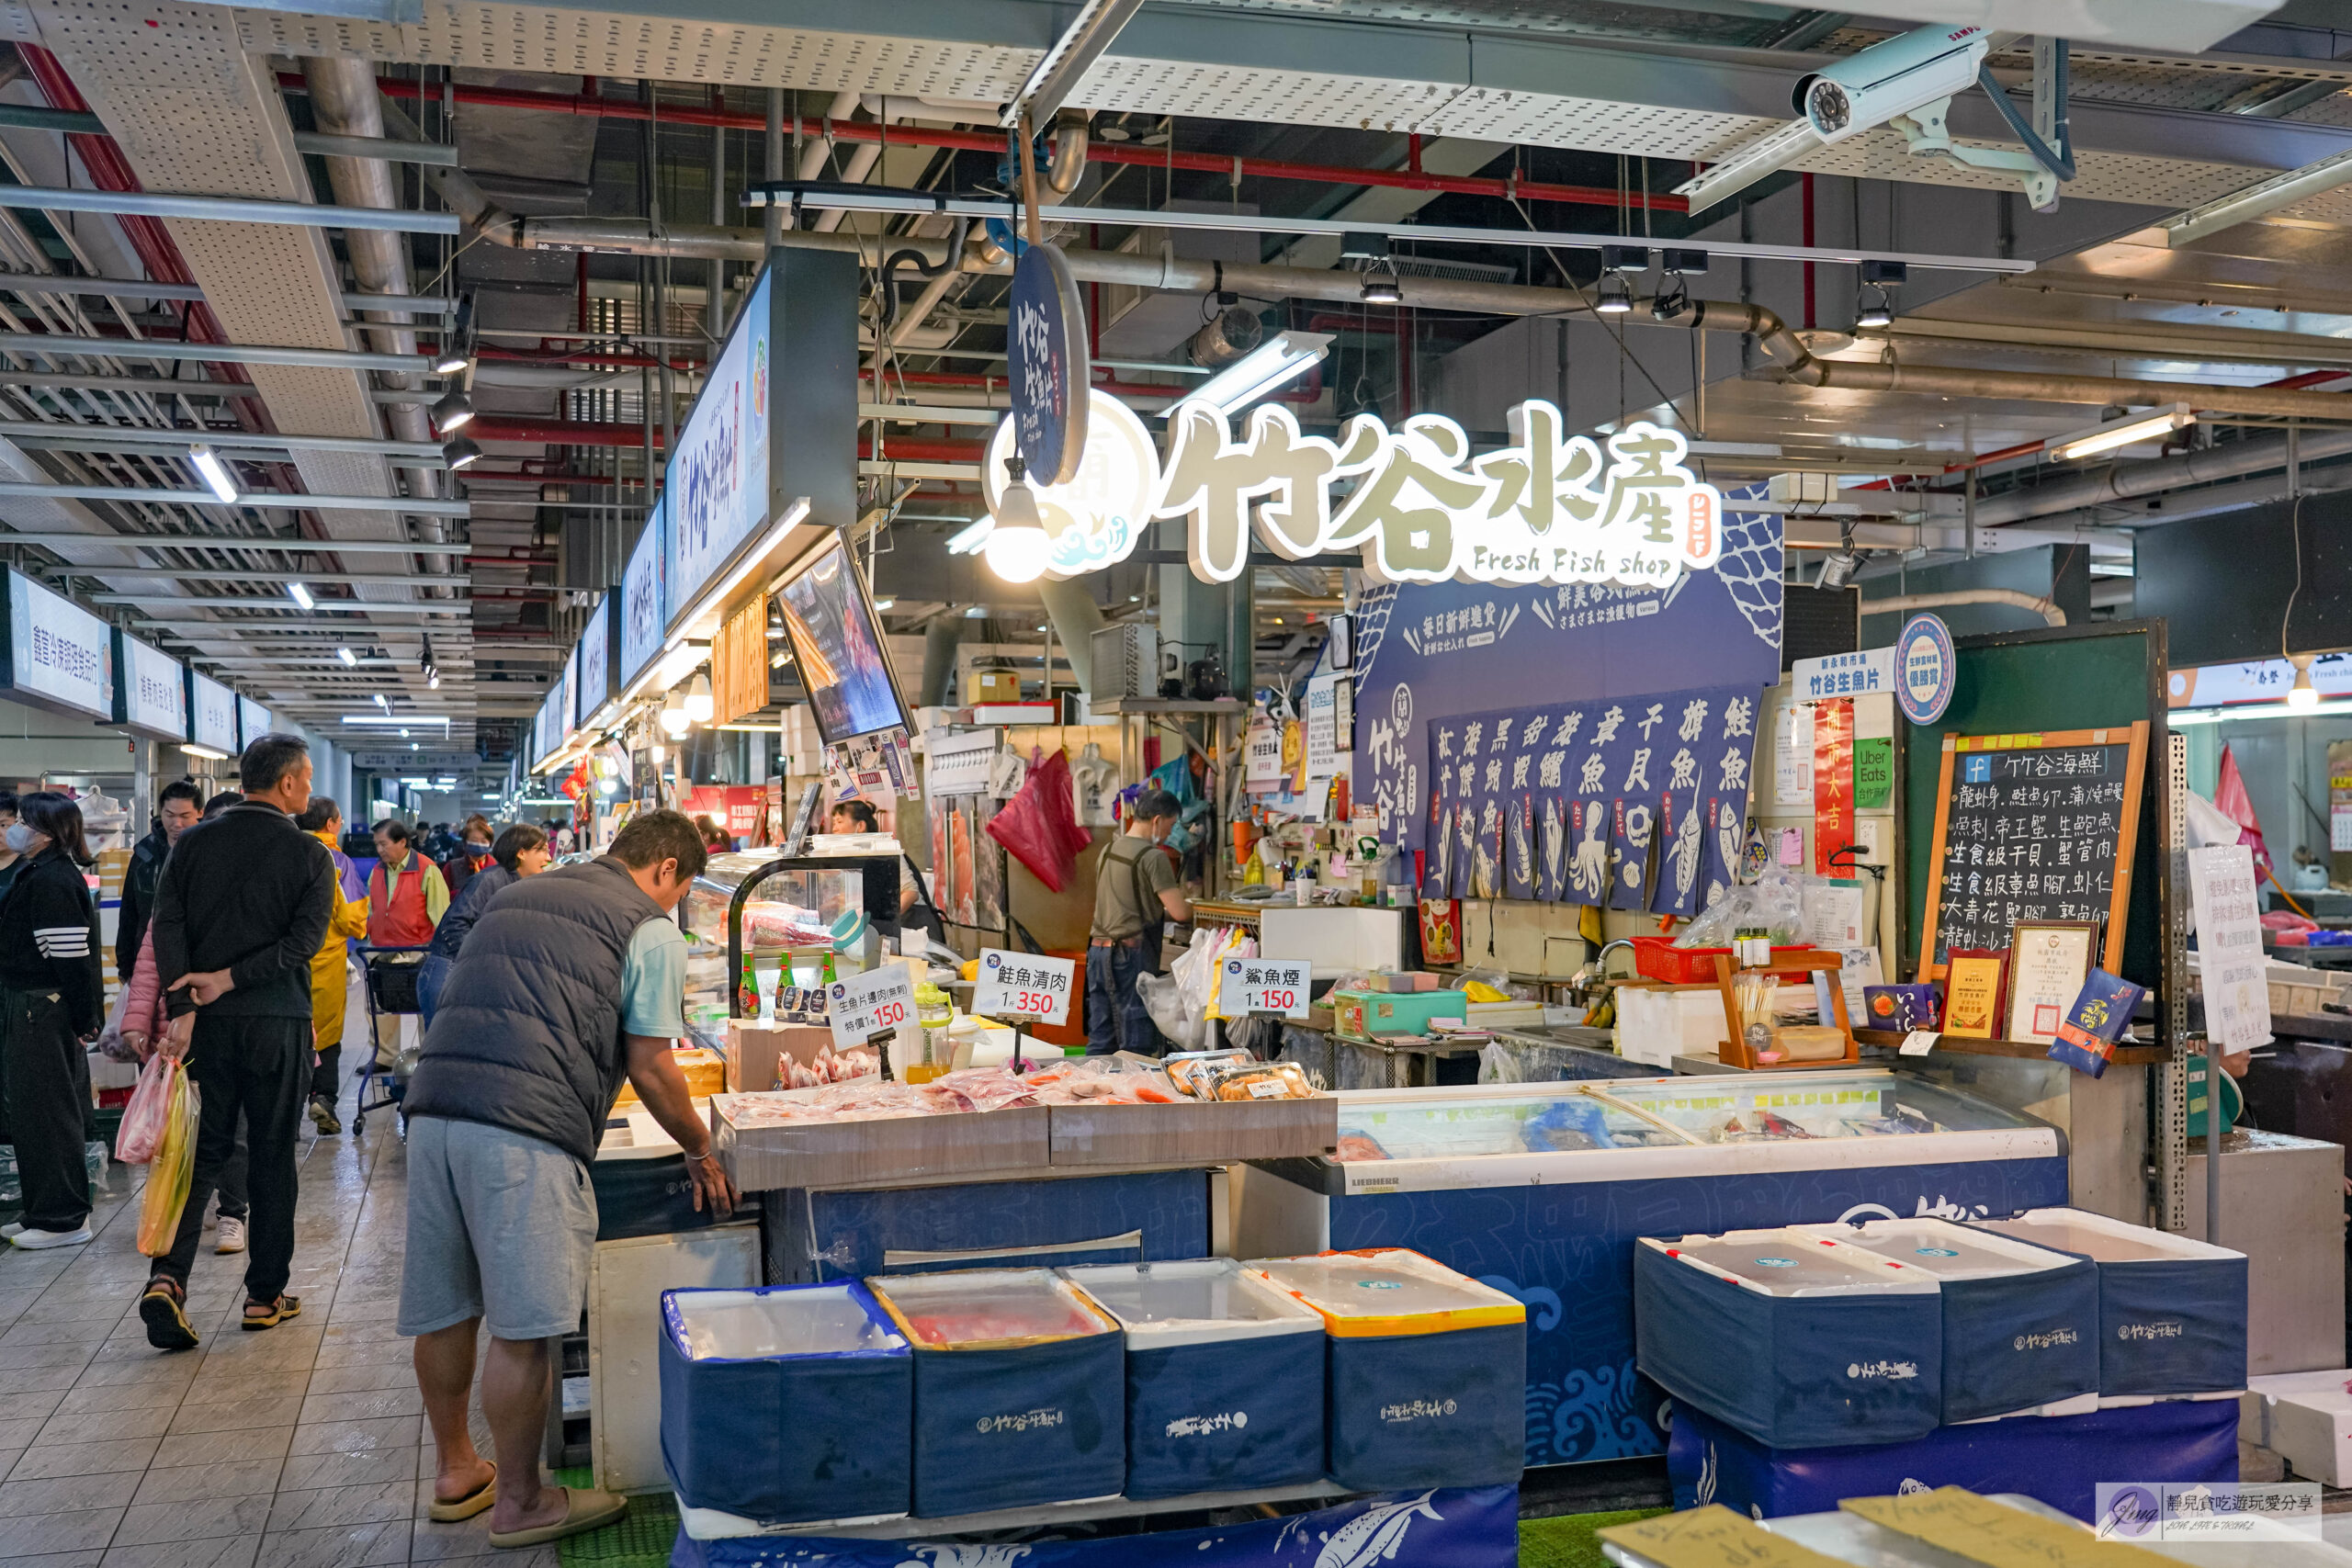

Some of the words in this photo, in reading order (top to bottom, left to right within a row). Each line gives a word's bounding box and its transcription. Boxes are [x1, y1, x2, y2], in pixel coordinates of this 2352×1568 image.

[1017, 300, 1049, 364] 竹谷
[1024, 362, 1054, 414] 生魚片
[1023, 411, 1039, 434] Fresh
[1154, 402, 1686, 577] 竹谷水產
[1473, 550, 1540, 575] Fresh
[1552, 548, 1607, 575] Fish
[1619, 554, 1672, 581] shop
[1821, 653, 1867, 670] 新永和市場
[2314, 669, 2337, 680] Fresh
[1810, 668, 1880, 695] 竹谷生魚片
[1578, 705, 1624, 795] 章魚
[1623, 703, 1663, 792] 干貝
[1669, 698, 1709, 790] 旗魚
[1719, 696, 1752, 791] 鮭魚
[1860, 750, 1886, 766] Uber
[1368, 717, 1395, 831] 竹谷
[1826, 706, 1842, 830] 開市大吉
[1860, 767, 1886, 783] Eats
[2005, 750, 2102, 778] 竹谷海鮮
[1392, 744, 1408, 852] 生魚片
[1574, 802, 1581, 827] たこ
[1615, 801, 1624, 834] ほたて
[997, 964, 1067, 992] 鮭魚清肉
[1245, 967, 1301, 987] 鯊魚煙
[839, 984, 908, 1013] 生魚片邊肉(無刺)
[1351, 1177, 1399, 1187] LIEBHERR
